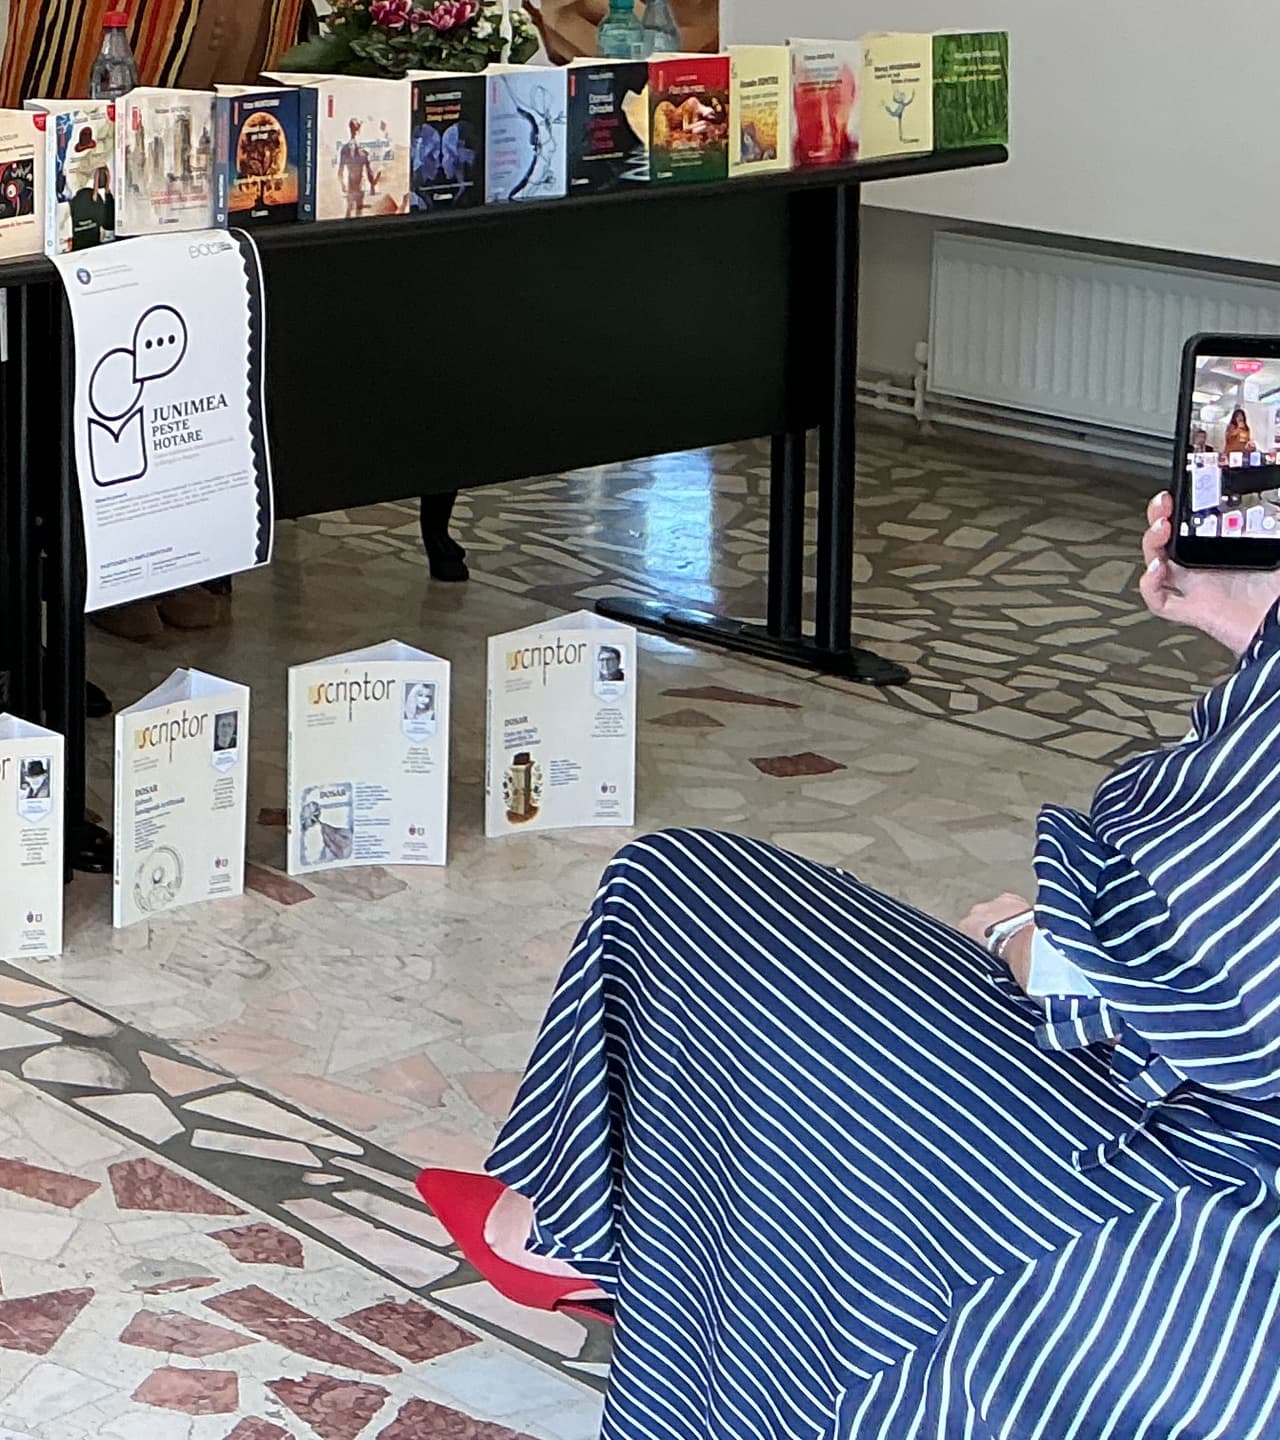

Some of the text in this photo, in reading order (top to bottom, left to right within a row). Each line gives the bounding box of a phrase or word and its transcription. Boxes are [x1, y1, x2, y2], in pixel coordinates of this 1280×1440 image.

[150, 393, 228, 424] JUNIMEA
[152, 418, 190, 437] PESTE
[153, 430, 203, 451] HOTARE
[510, 635, 587, 686] scriptor
[313, 668, 396, 722] scriptor
[139, 708, 208, 763] scriptor
